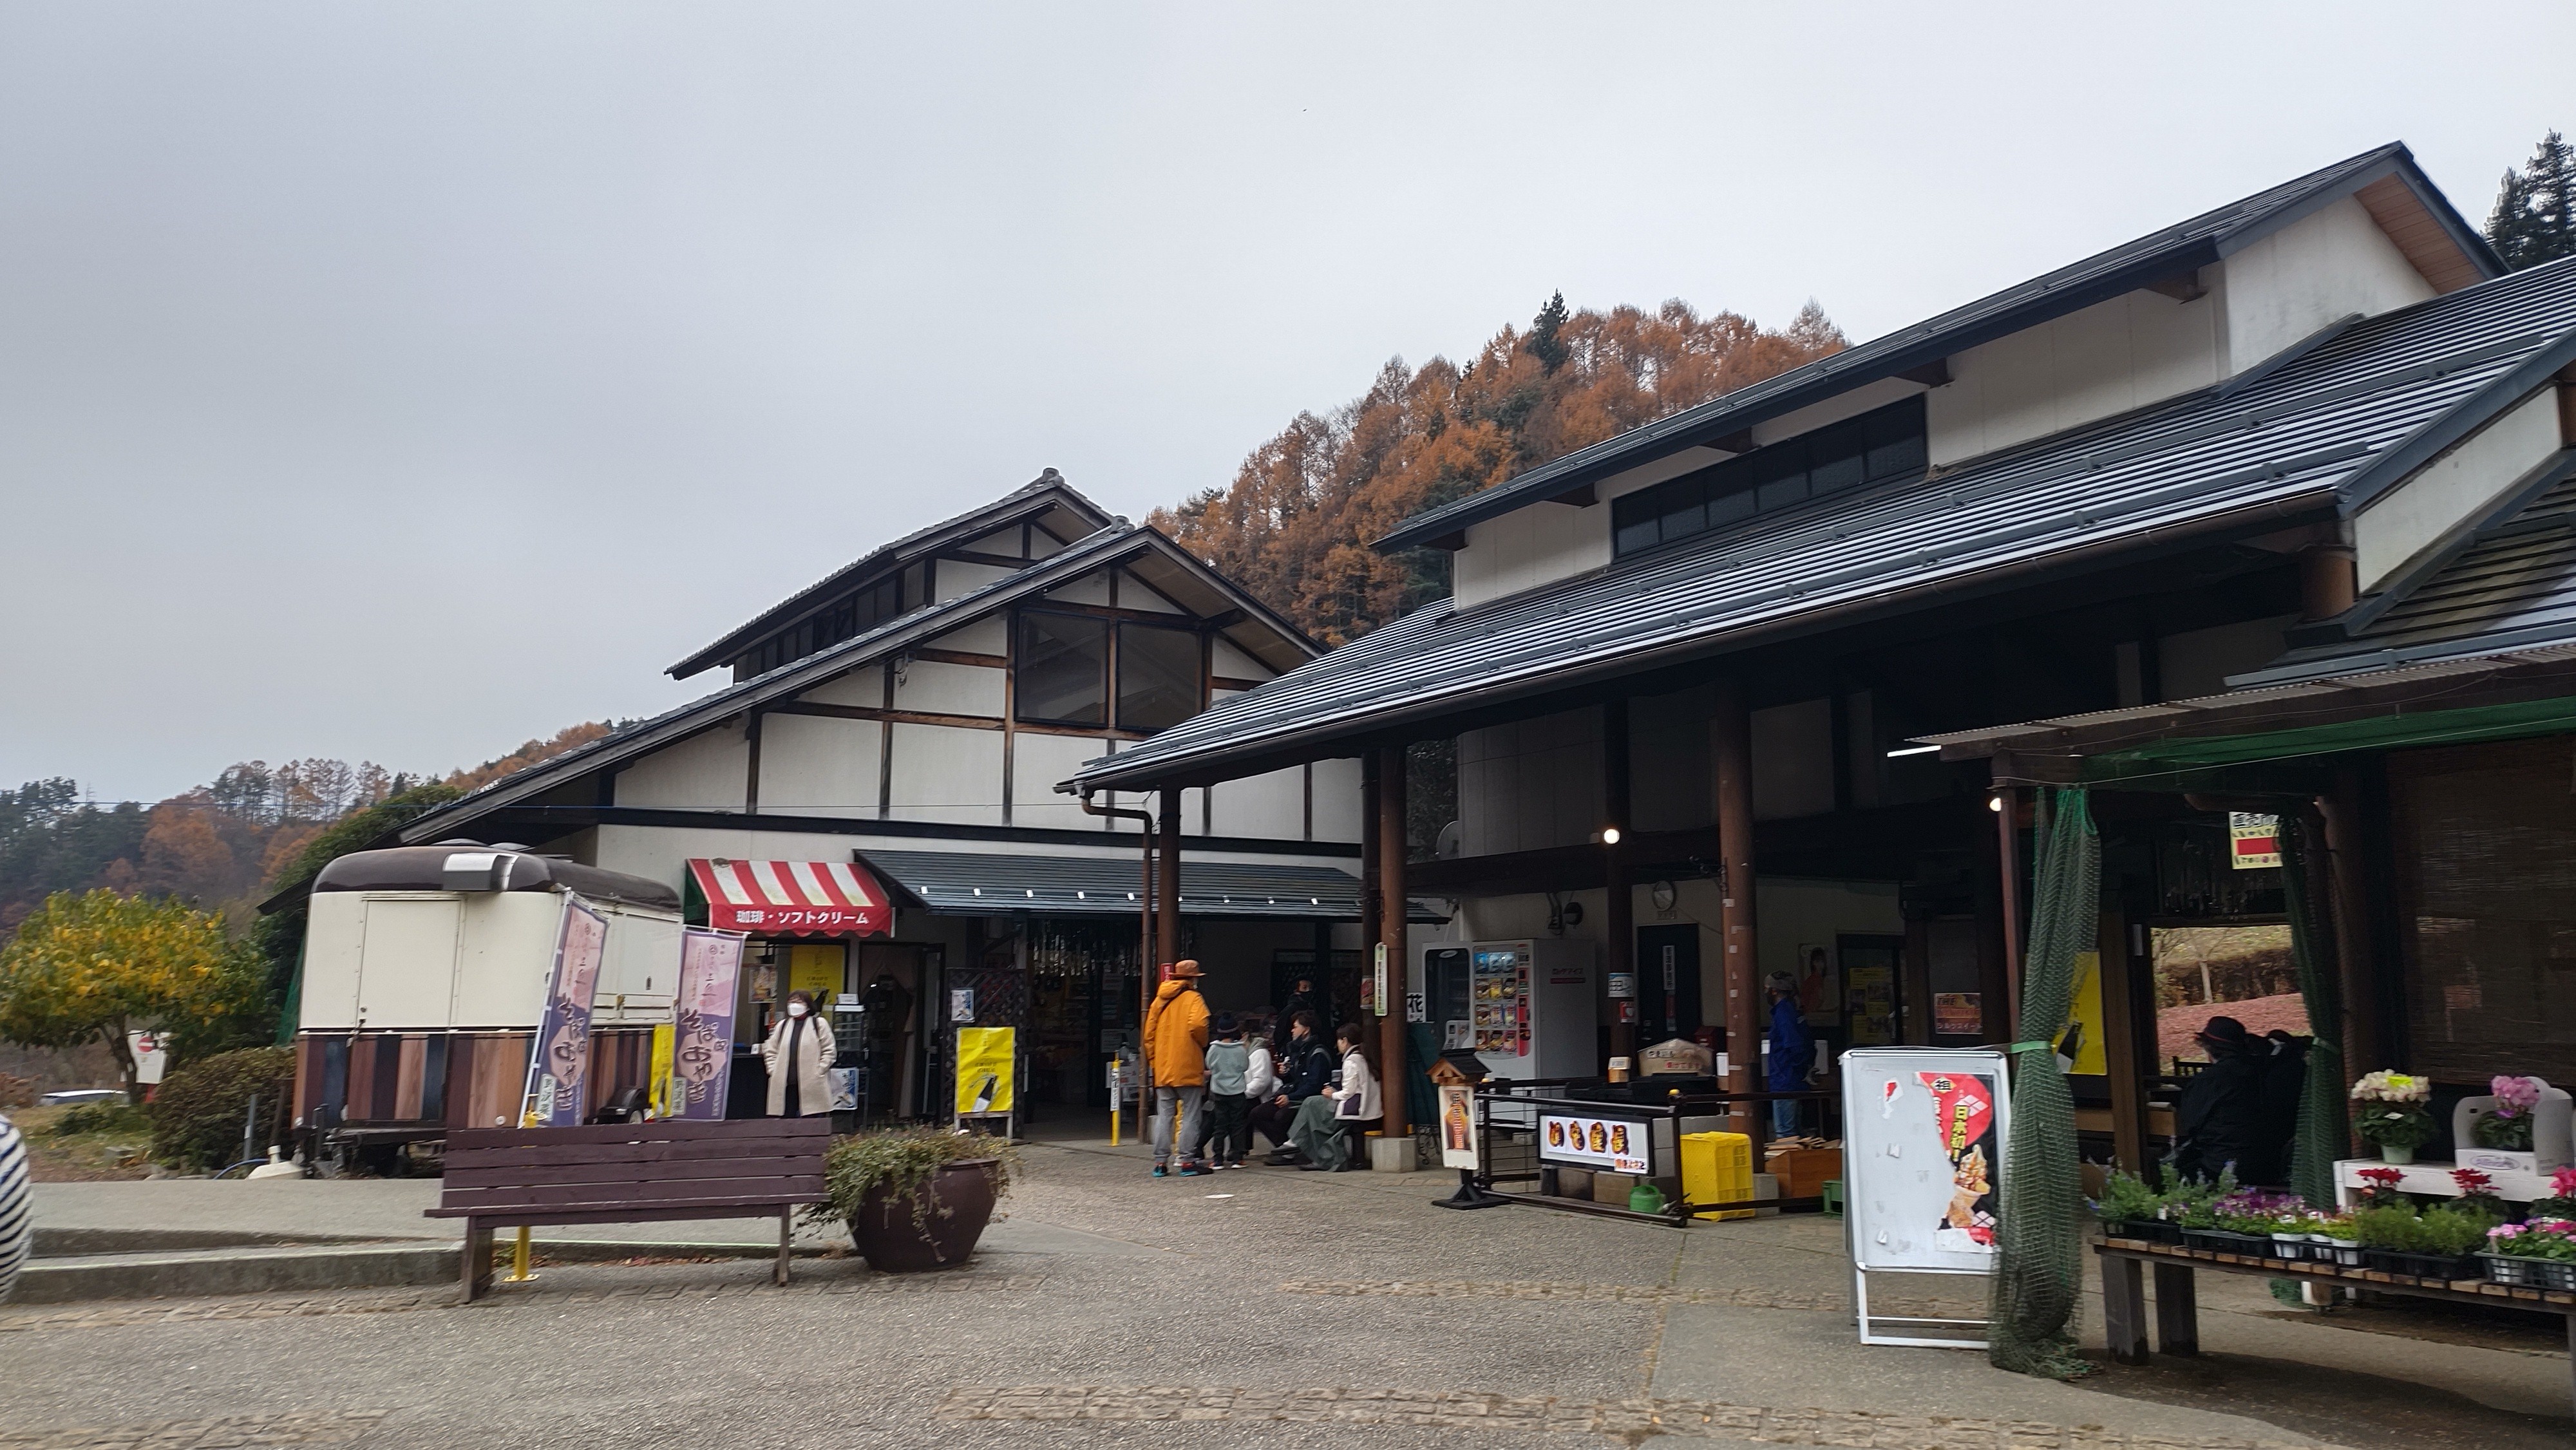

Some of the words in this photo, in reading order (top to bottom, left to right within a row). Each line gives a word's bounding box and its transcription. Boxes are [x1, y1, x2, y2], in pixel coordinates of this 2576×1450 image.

[736, 910, 869, 925] 珈琲・ソフトクリーム
[1406, 993, 1423, 1013] 花
[1935, 1080, 1953, 1091] 祖
[1949, 1104, 1969, 1163] 日本初!
